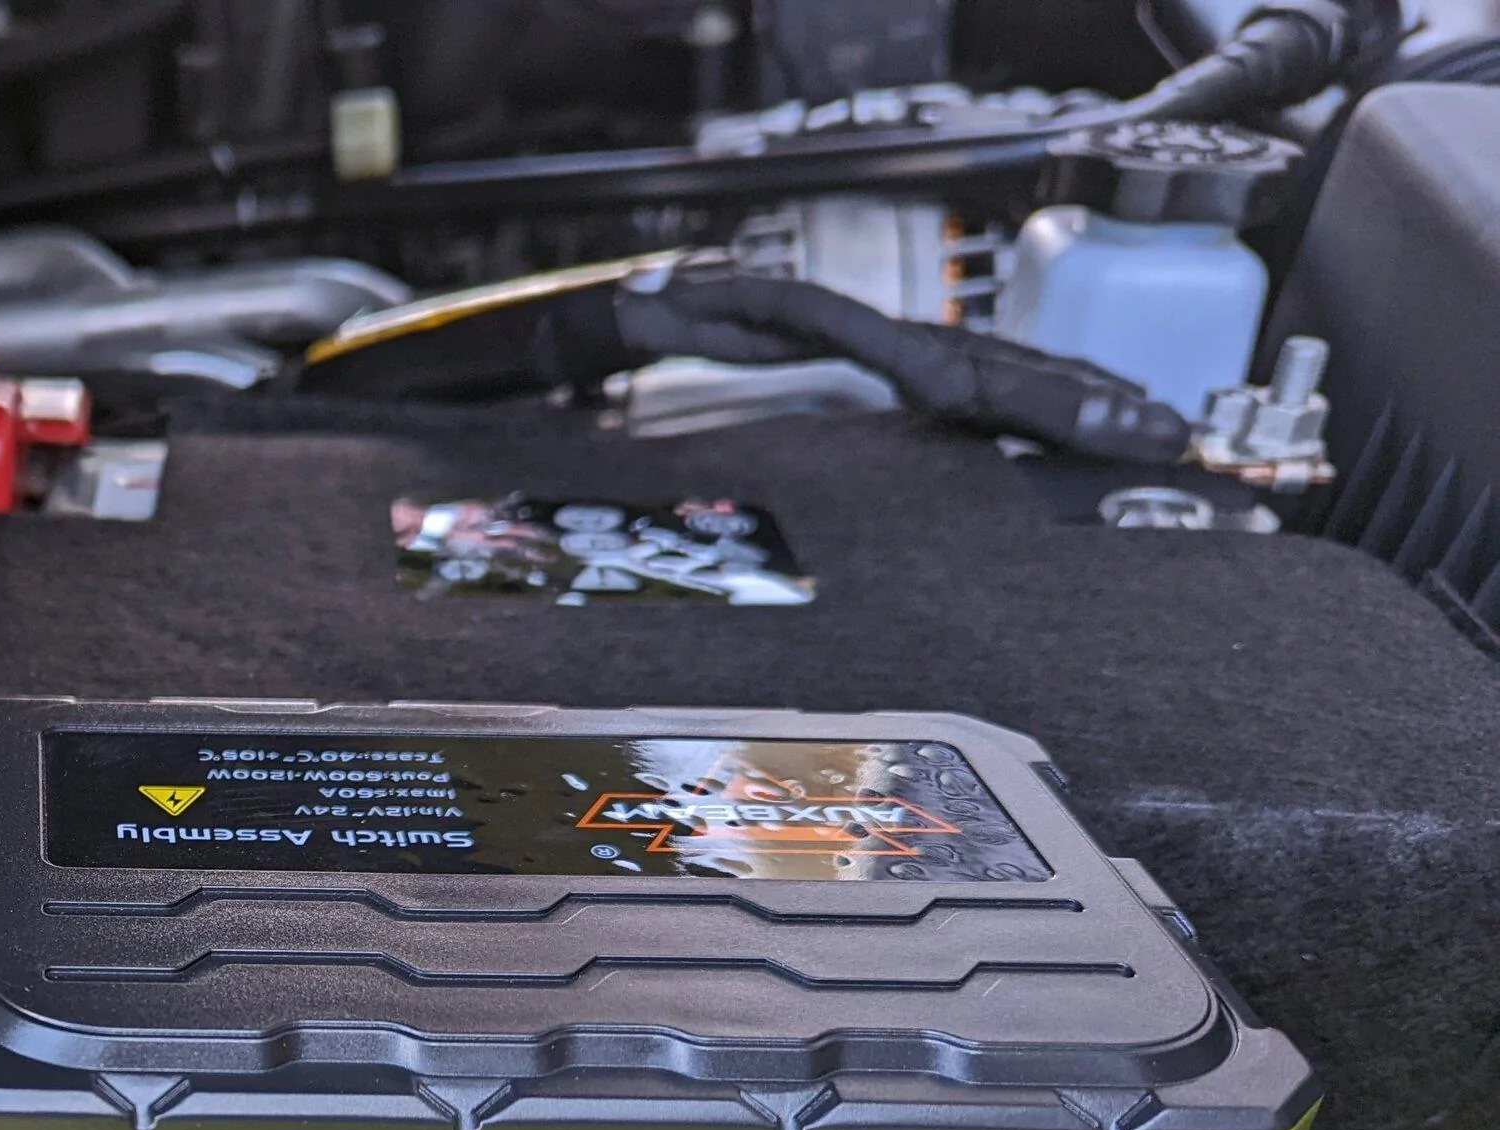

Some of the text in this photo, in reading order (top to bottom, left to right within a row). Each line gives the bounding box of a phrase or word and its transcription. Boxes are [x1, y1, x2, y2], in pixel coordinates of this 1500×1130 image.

[606, 802, 905, 823] AUXBEAM
[117, 823, 475, 848] Switch Assembly
